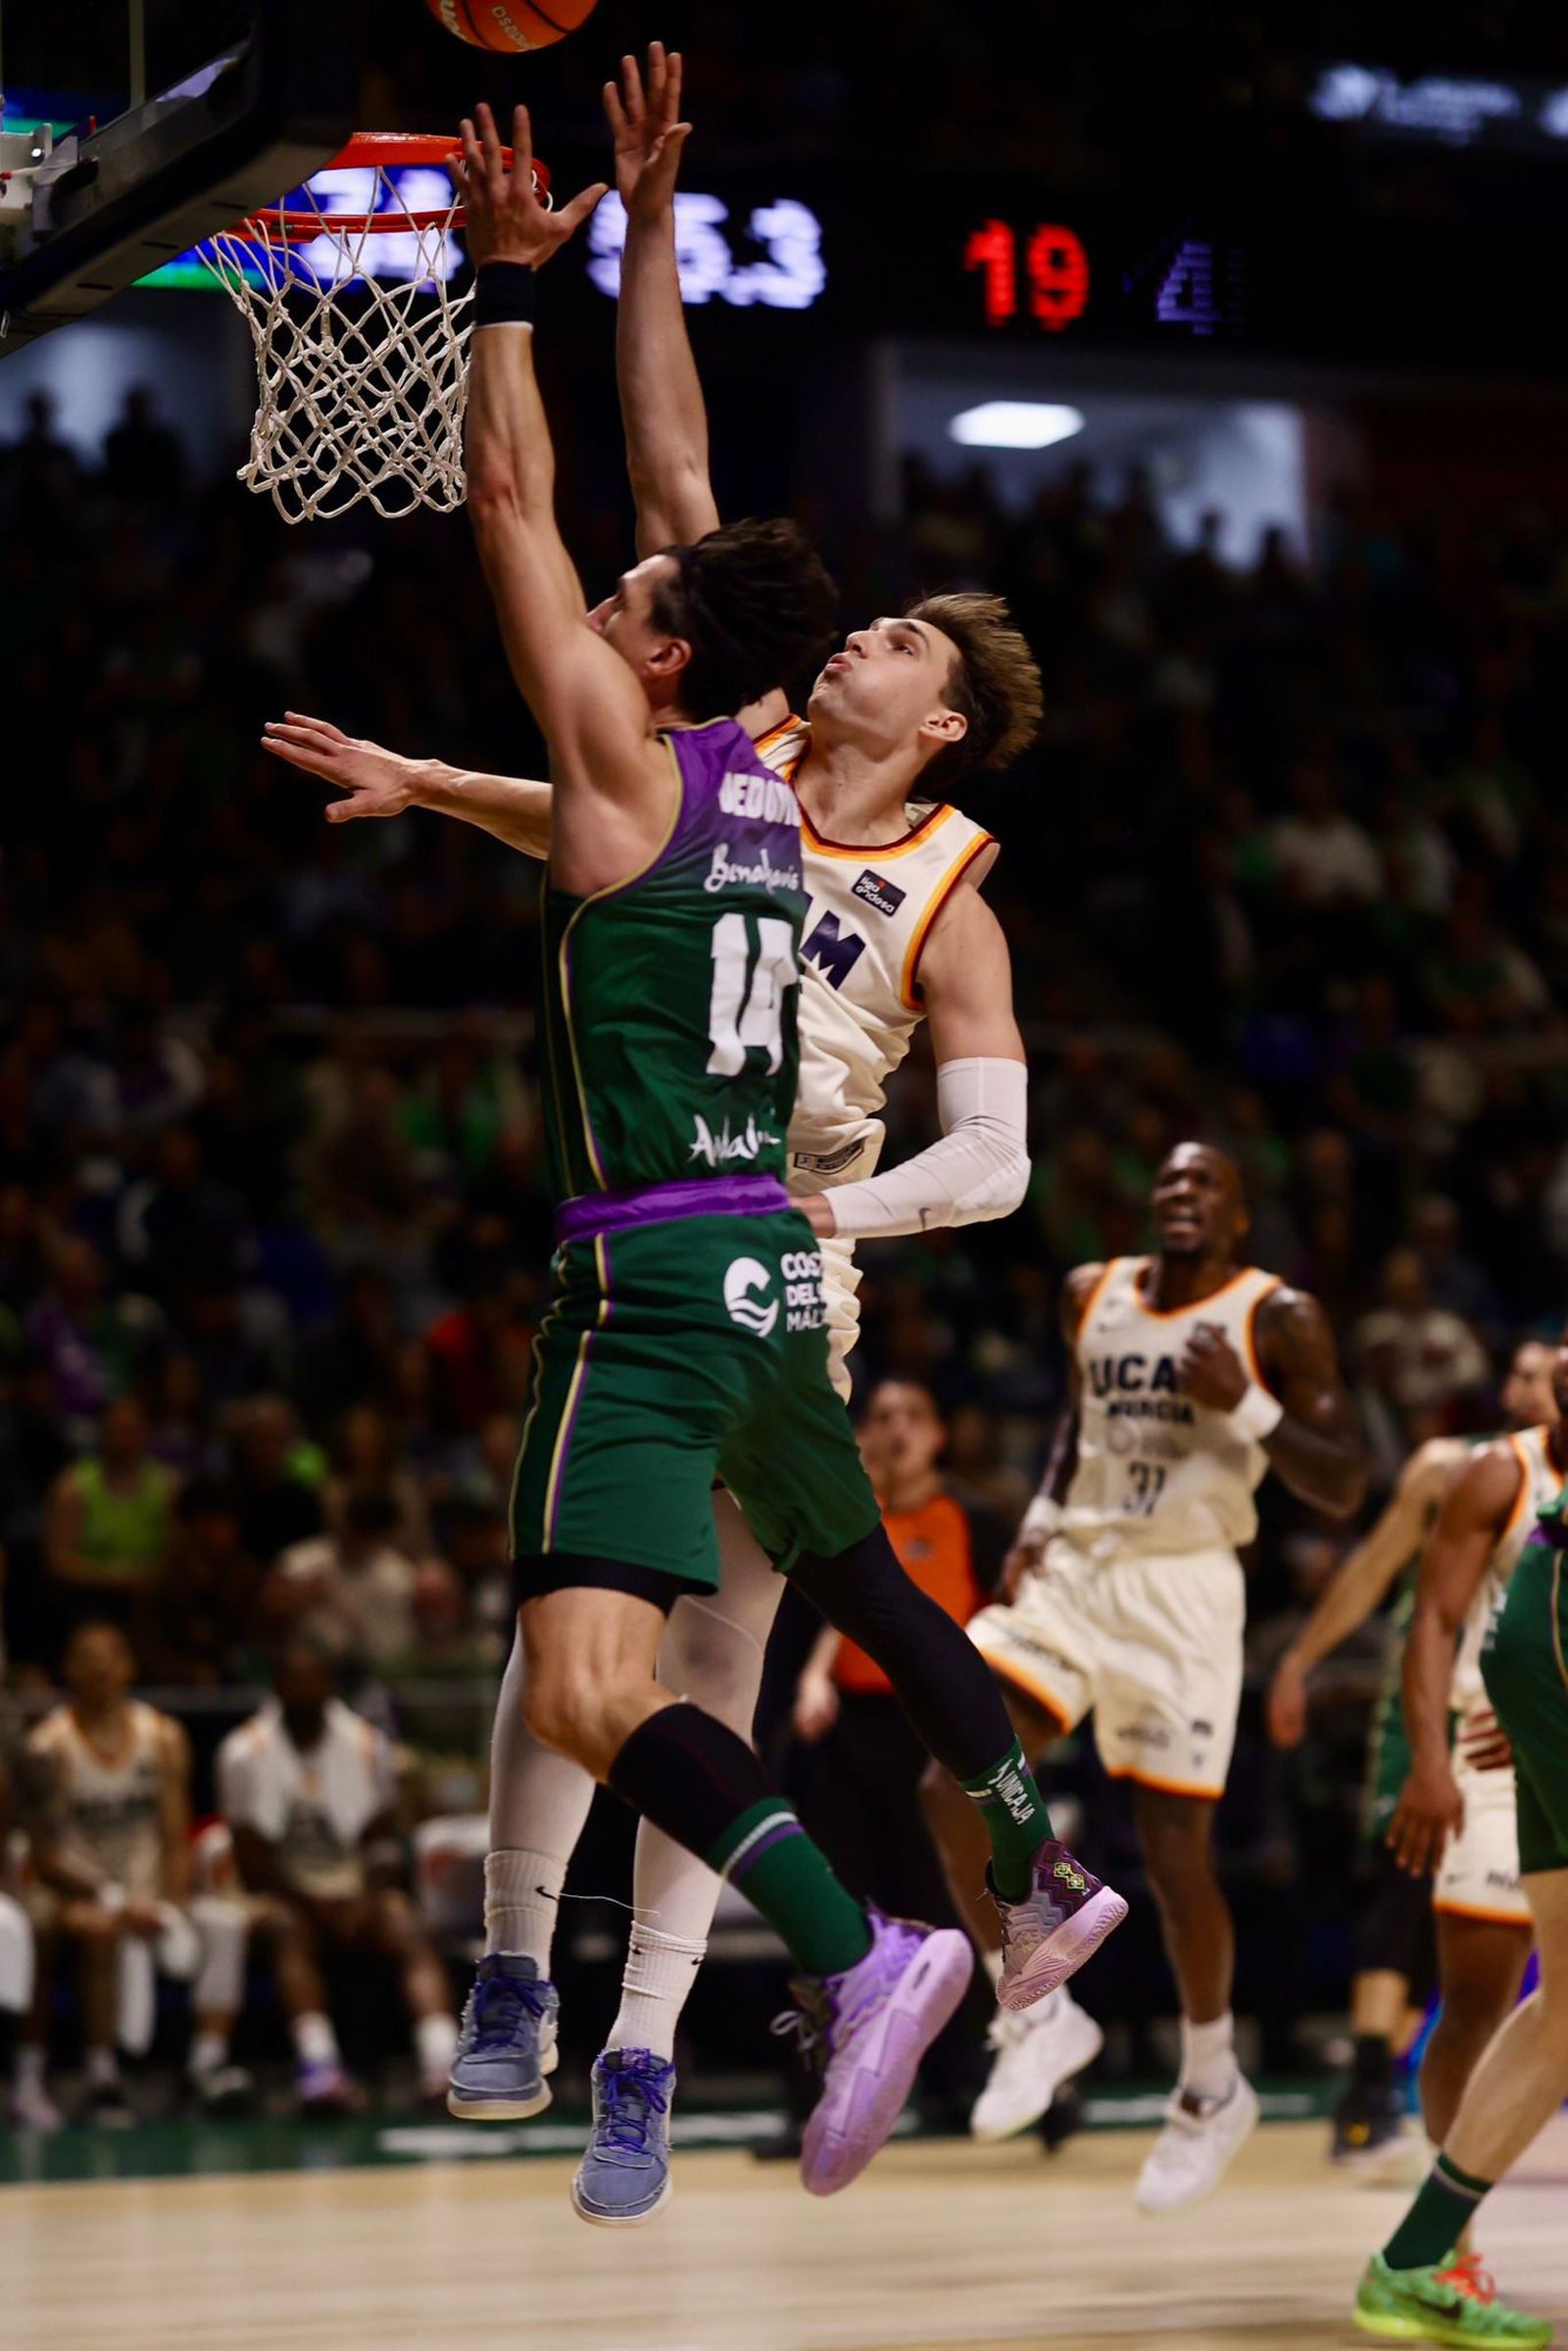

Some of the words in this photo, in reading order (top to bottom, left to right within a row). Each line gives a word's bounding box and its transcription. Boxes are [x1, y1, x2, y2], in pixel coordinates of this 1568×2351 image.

[964, 218, 1090, 330] 19
[856, 885, 896, 913] endesa
[706, 912, 800, 1077] 14
[781, 1251, 820, 1281] COS
[786, 1283, 819, 1307] DEL
[1090, 1352, 1180, 1397] UCA
[996, 1770, 1036, 1825] UNICAJA
